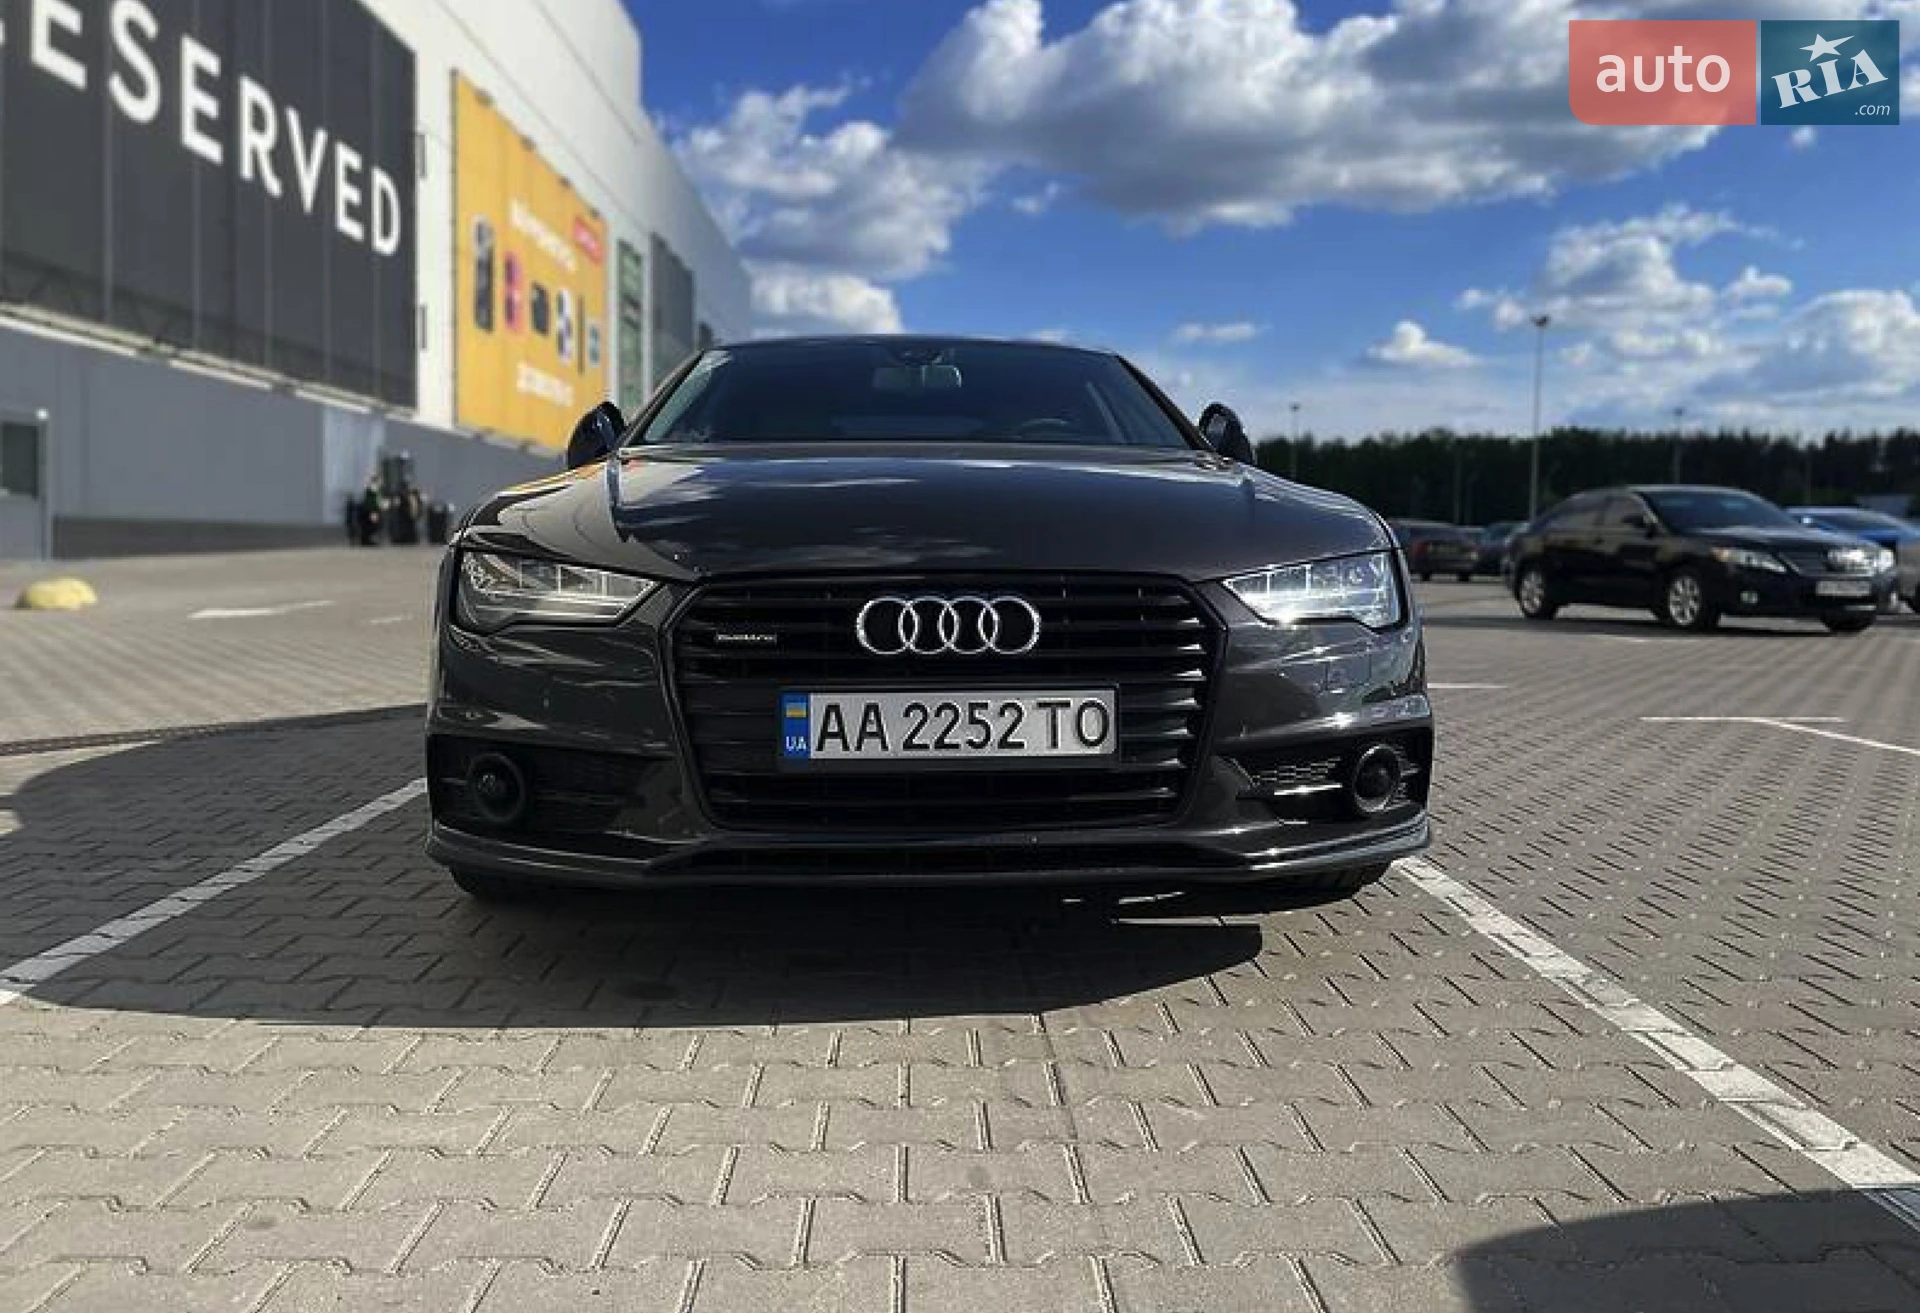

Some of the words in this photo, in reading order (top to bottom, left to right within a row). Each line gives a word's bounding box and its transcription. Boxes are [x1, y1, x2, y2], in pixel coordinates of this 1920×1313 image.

[0, 0, 400, 256] ESERVED
[785, 736, 807, 751] UA
[816, 702, 889, 751] AA
[902, 702, 1026, 750] 2252
[1036, 701, 1110, 749] TO
